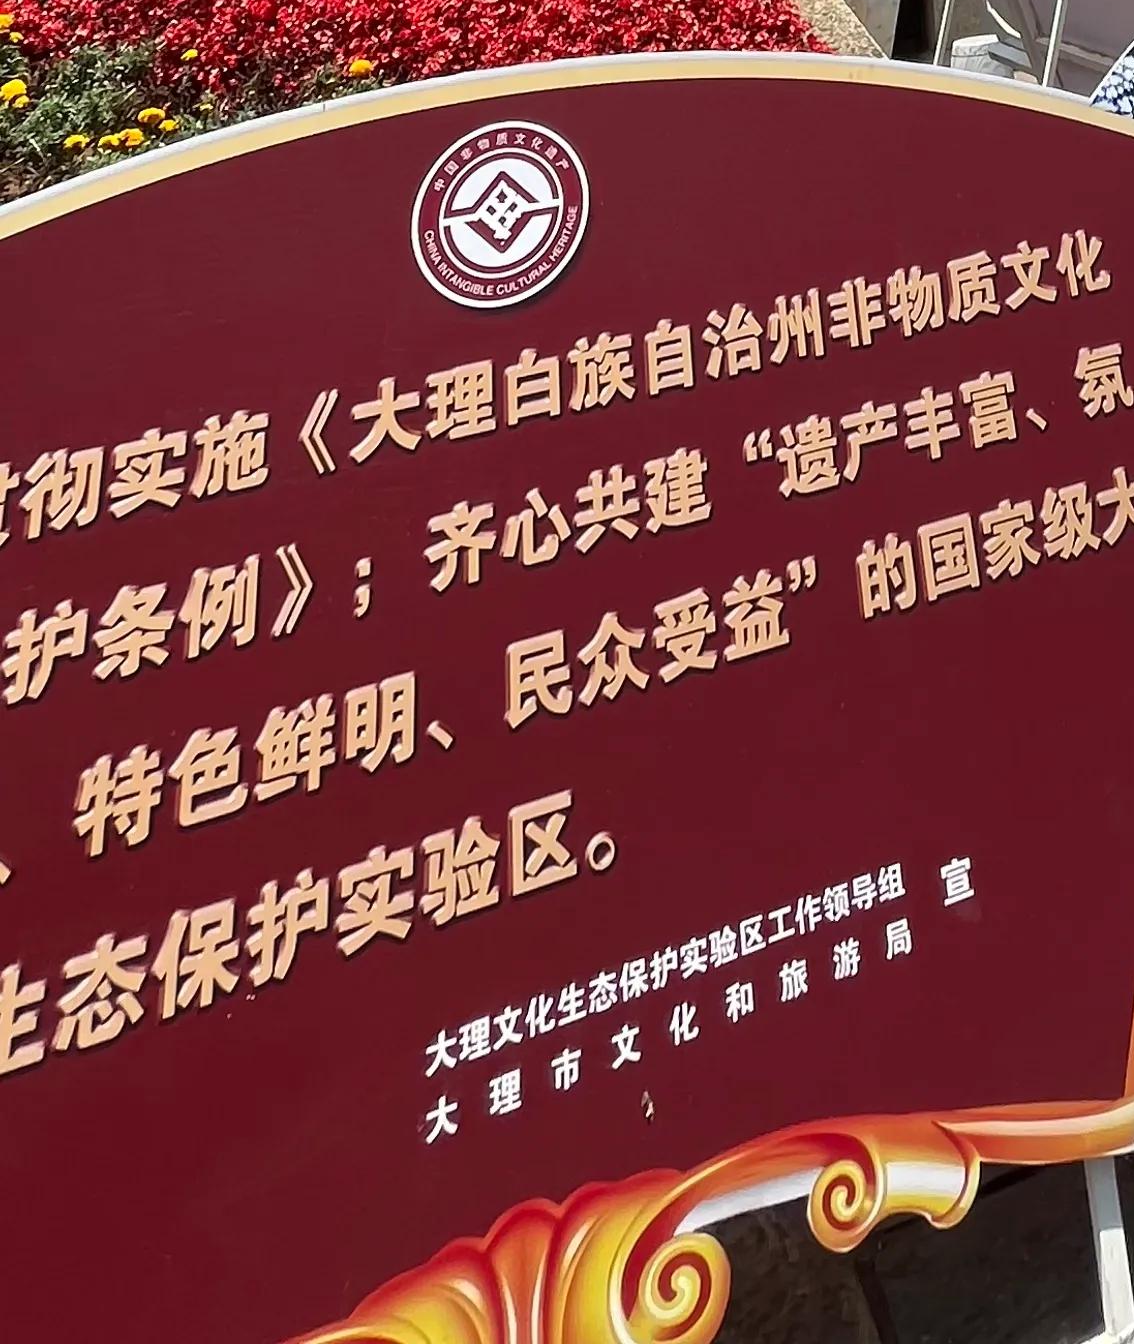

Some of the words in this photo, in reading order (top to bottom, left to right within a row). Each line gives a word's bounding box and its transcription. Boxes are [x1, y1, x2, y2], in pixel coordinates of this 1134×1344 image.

[424, 229, 442, 266] CHINA
[437, 261, 495, 296] INTANGIBLE
[496, 260, 552, 295] CULTURAL
[549, 204, 579, 262] HERITAGE
[433, 132, 570, 193] 中国非物质文化遗产
[0, 228, 1113, 547] 彻实施《大理白族自治州非物质文化
[424, 862, 906, 1079] 大理文化生态保护实验区工作领导组
[939, 857, 976, 907] 宣
[425, 918, 914, 1144] 大理市文化和旅游局
